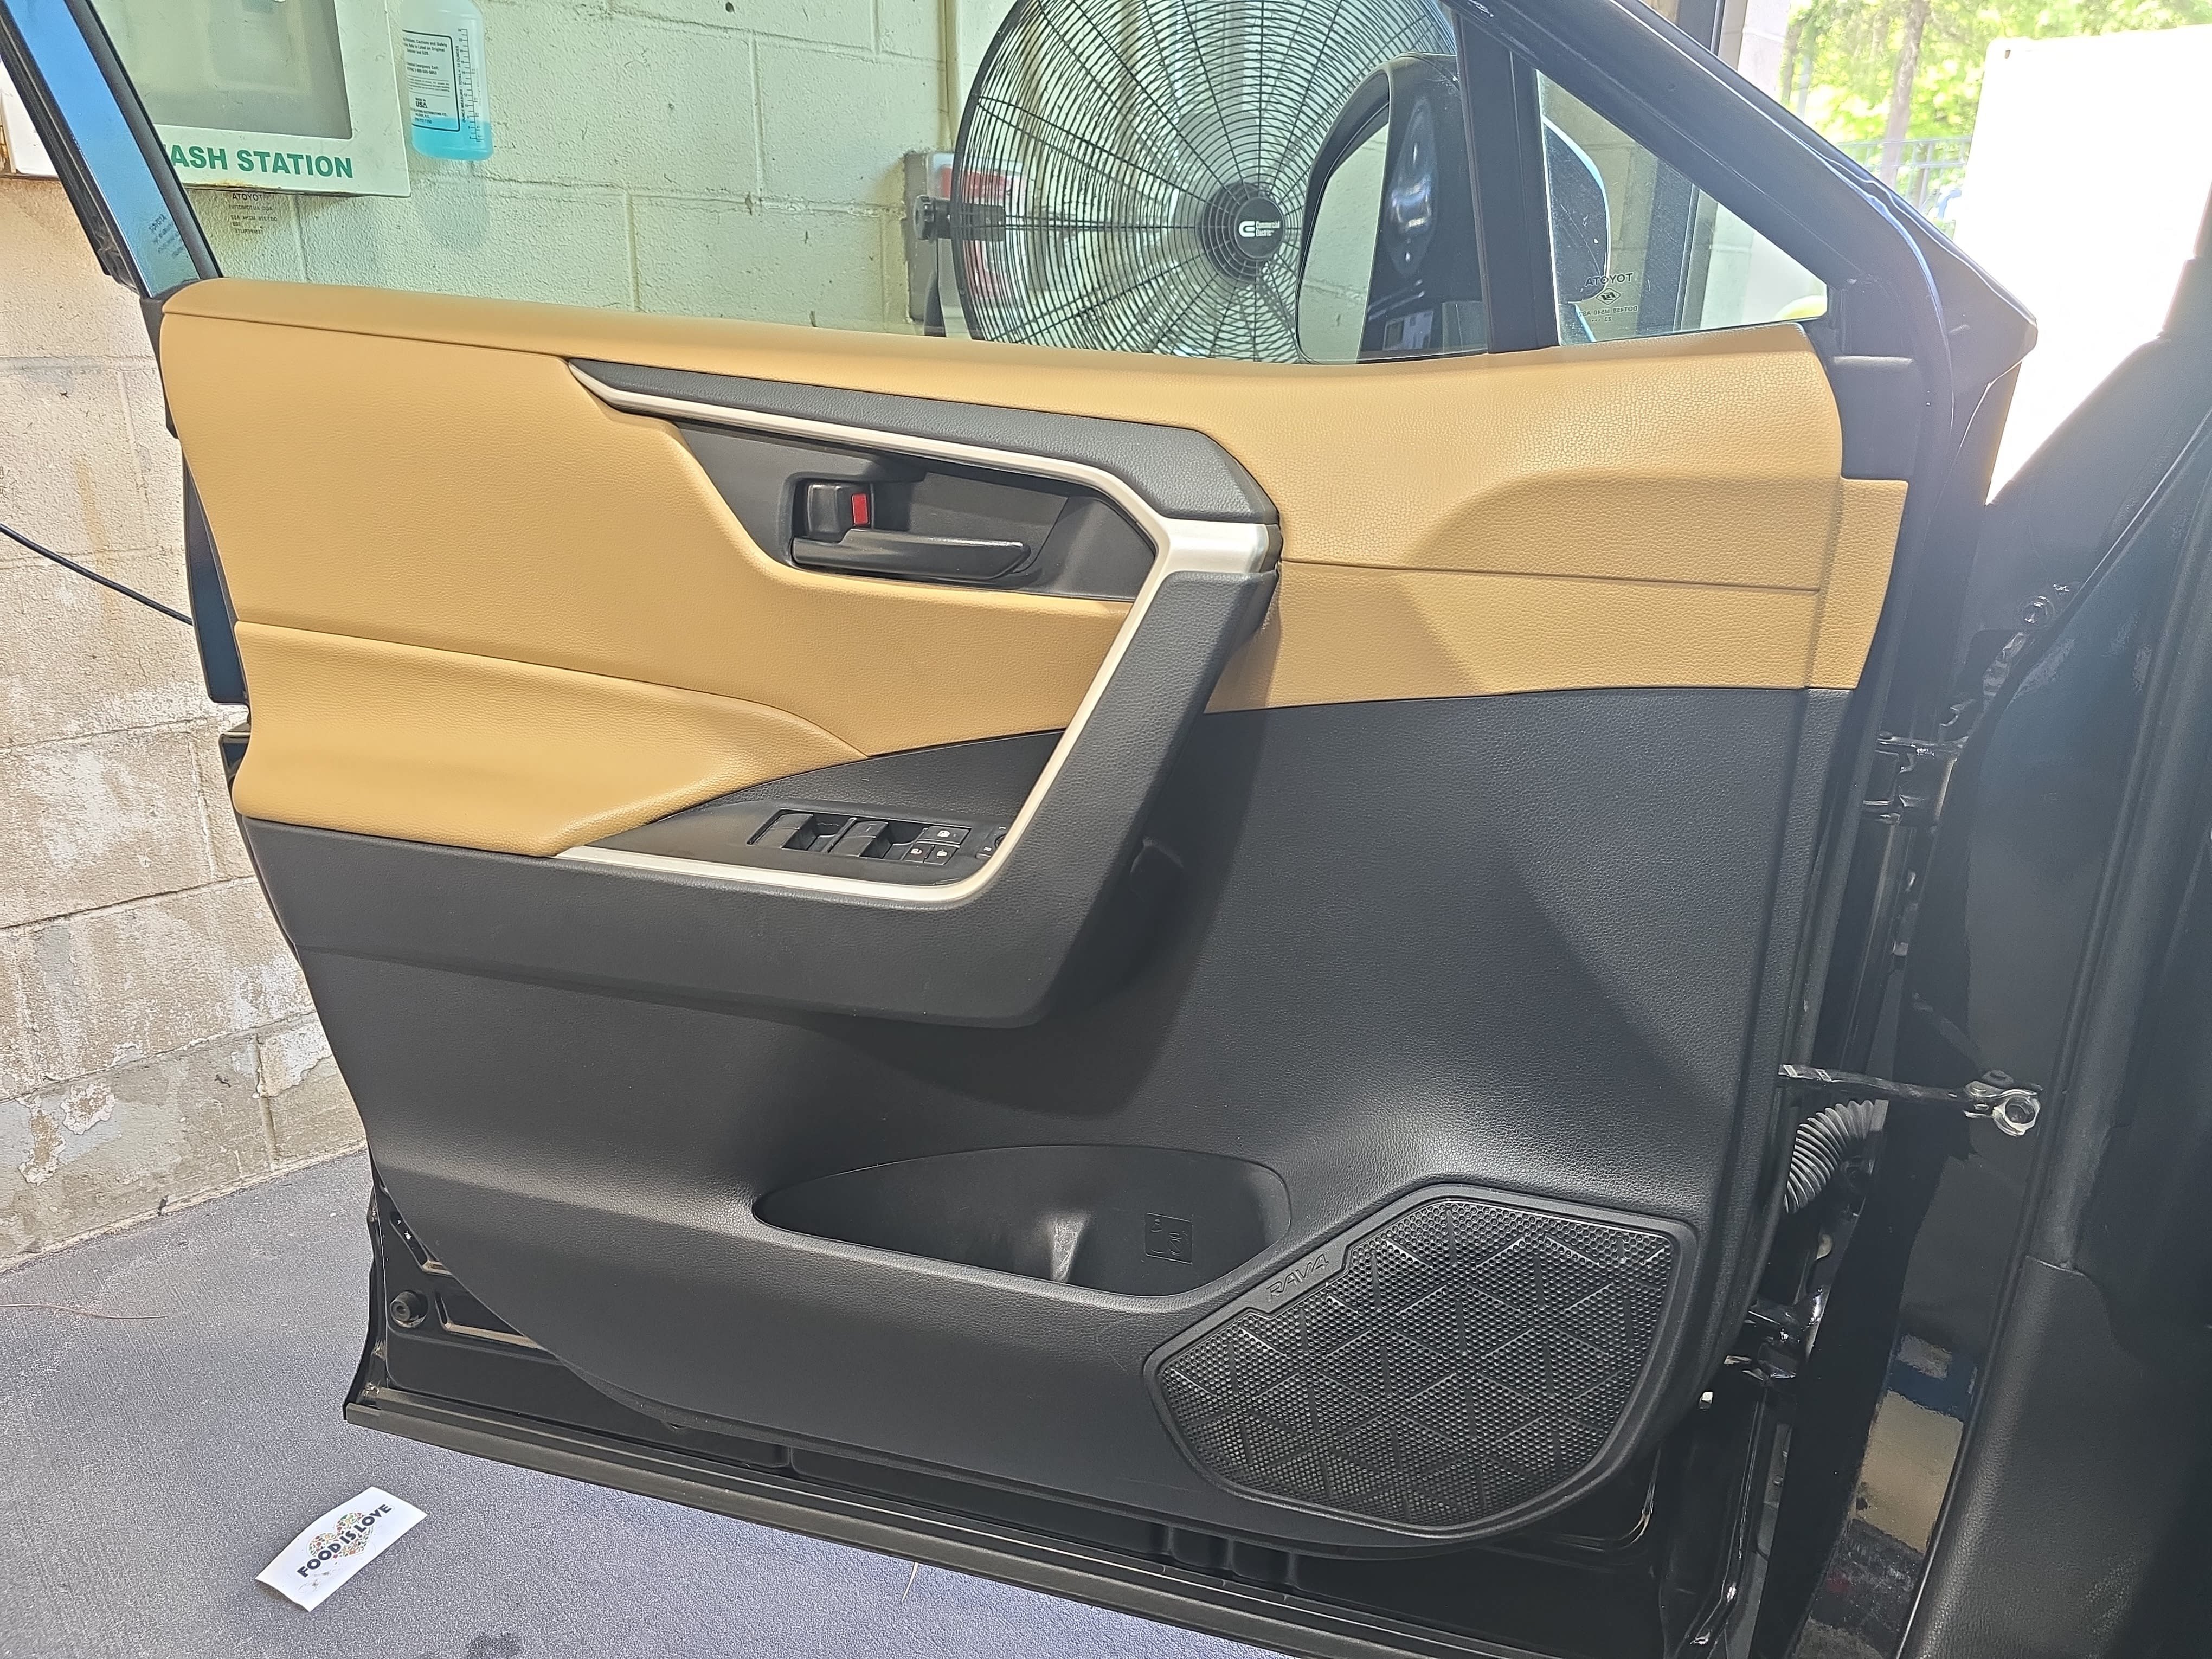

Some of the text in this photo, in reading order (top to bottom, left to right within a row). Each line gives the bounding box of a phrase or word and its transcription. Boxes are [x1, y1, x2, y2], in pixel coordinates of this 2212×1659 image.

[163, 144, 354, 178] ASH STATION
[1266, 1253, 1329, 1300] RAV4
[297, 1504, 393, 1578] FOOD IS LOVE
